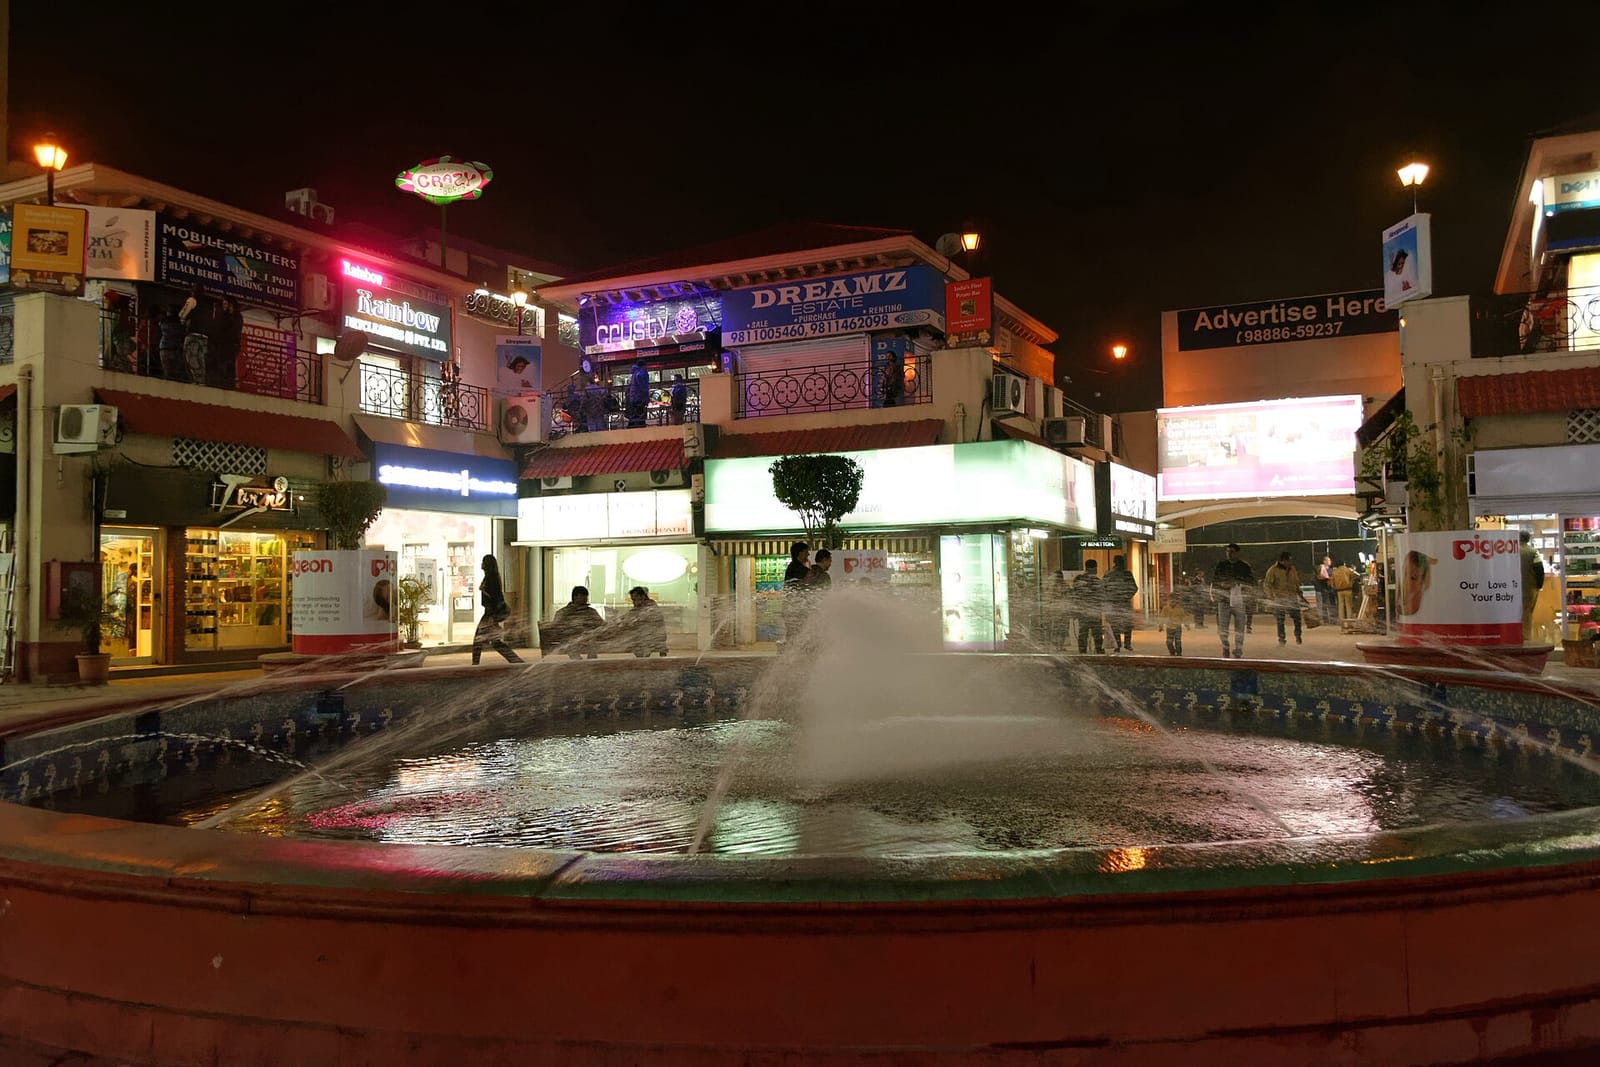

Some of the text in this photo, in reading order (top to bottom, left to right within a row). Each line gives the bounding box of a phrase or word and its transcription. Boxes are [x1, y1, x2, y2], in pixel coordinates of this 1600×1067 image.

[417, 171, 477, 188] CRAZY
[177, 251, 220, 270] PHONE
[168, 261, 194, 276] BLACK
[197, 266, 224, 282] BERRY
[752, 271, 907, 309] DREAMZ
[357, 288, 440, 333] Rainbow
[791, 297, 864, 315] ESTATE
[1194, 296, 1393, 332] Advertise Here
[596, 307, 669, 346] crusty
[751, 320, 769, 332] SALE
[798, 312, 837, 326] PURCHASE
[810, 314, 889, 335] 9811462098
[1452, 534, 1519, 561] pigeon
[1459, 581, 1479, 591] Our
[1488, 580, 1507, 590] Love
[1471, 593, 1515, 603] Your Baby
